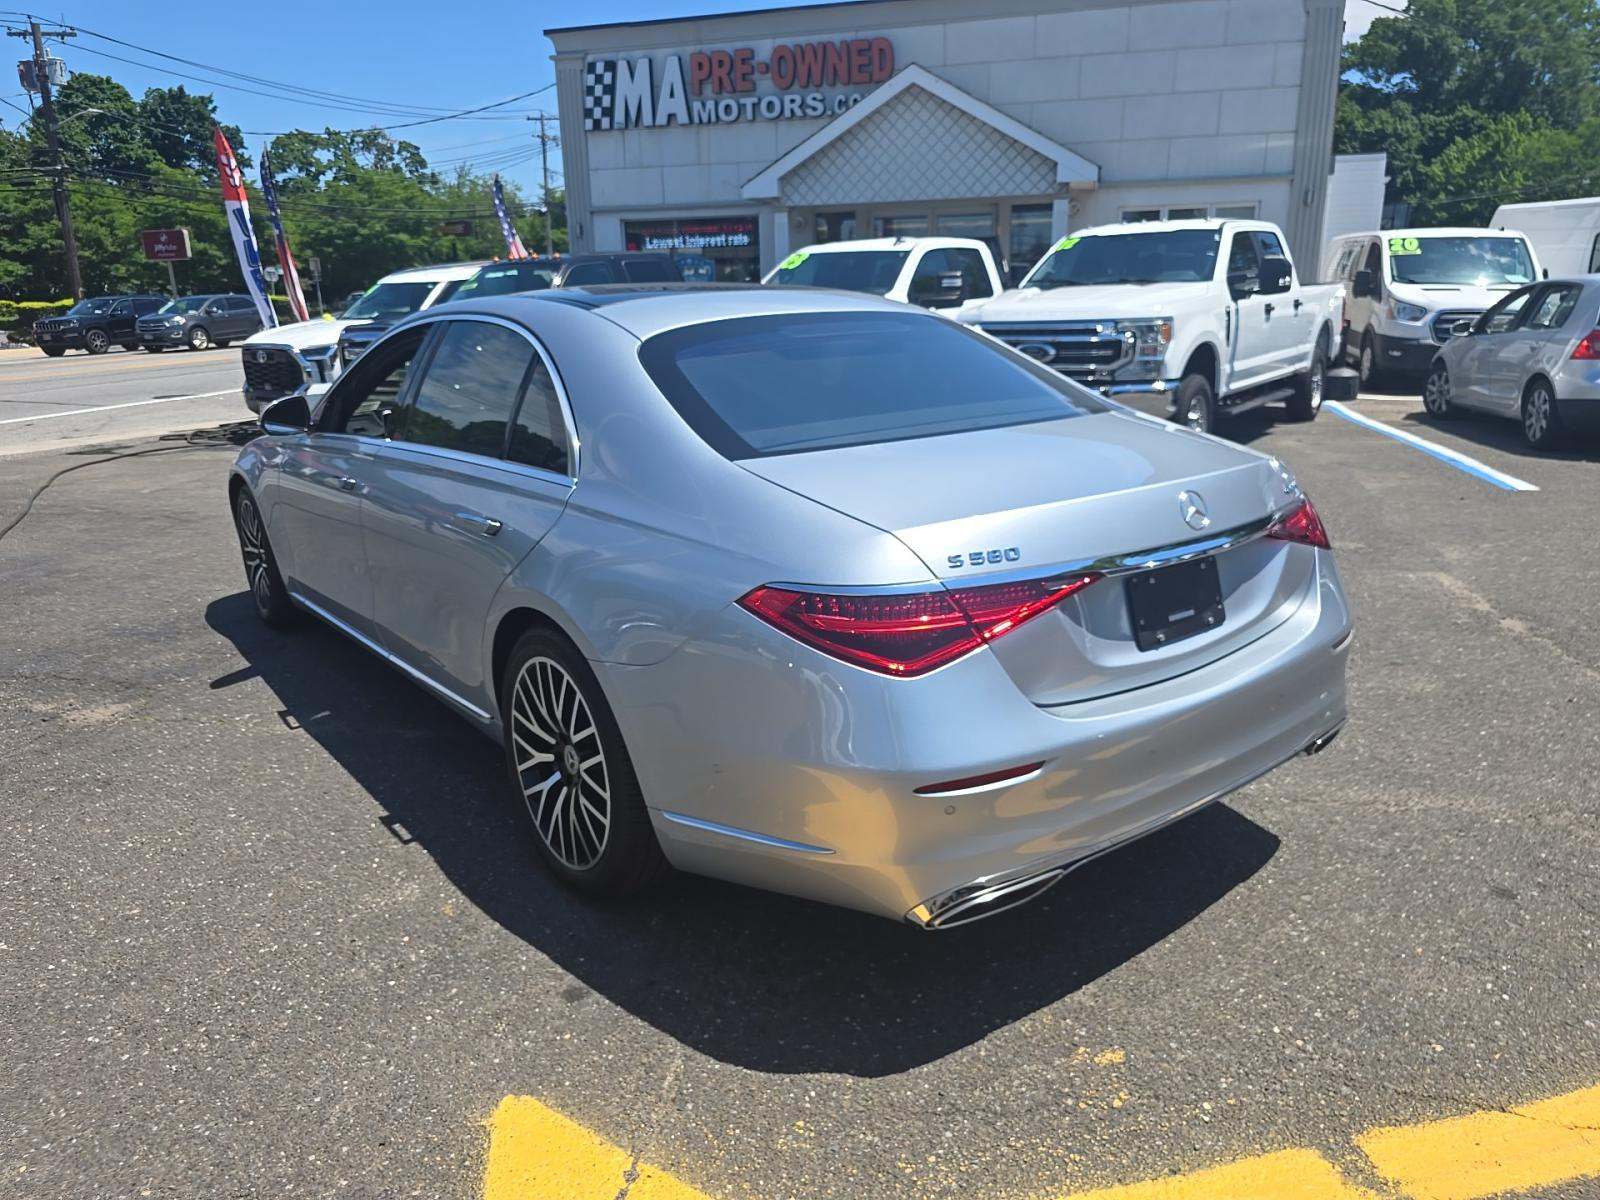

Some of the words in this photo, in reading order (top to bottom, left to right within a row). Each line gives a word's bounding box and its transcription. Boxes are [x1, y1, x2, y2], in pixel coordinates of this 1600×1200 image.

[612, 55, 690, 128] MA
[689, 37, 895, 95] PRE-OWNED
[947, 554, 964, 569] S
[968, 547, 1021, 566] 580
